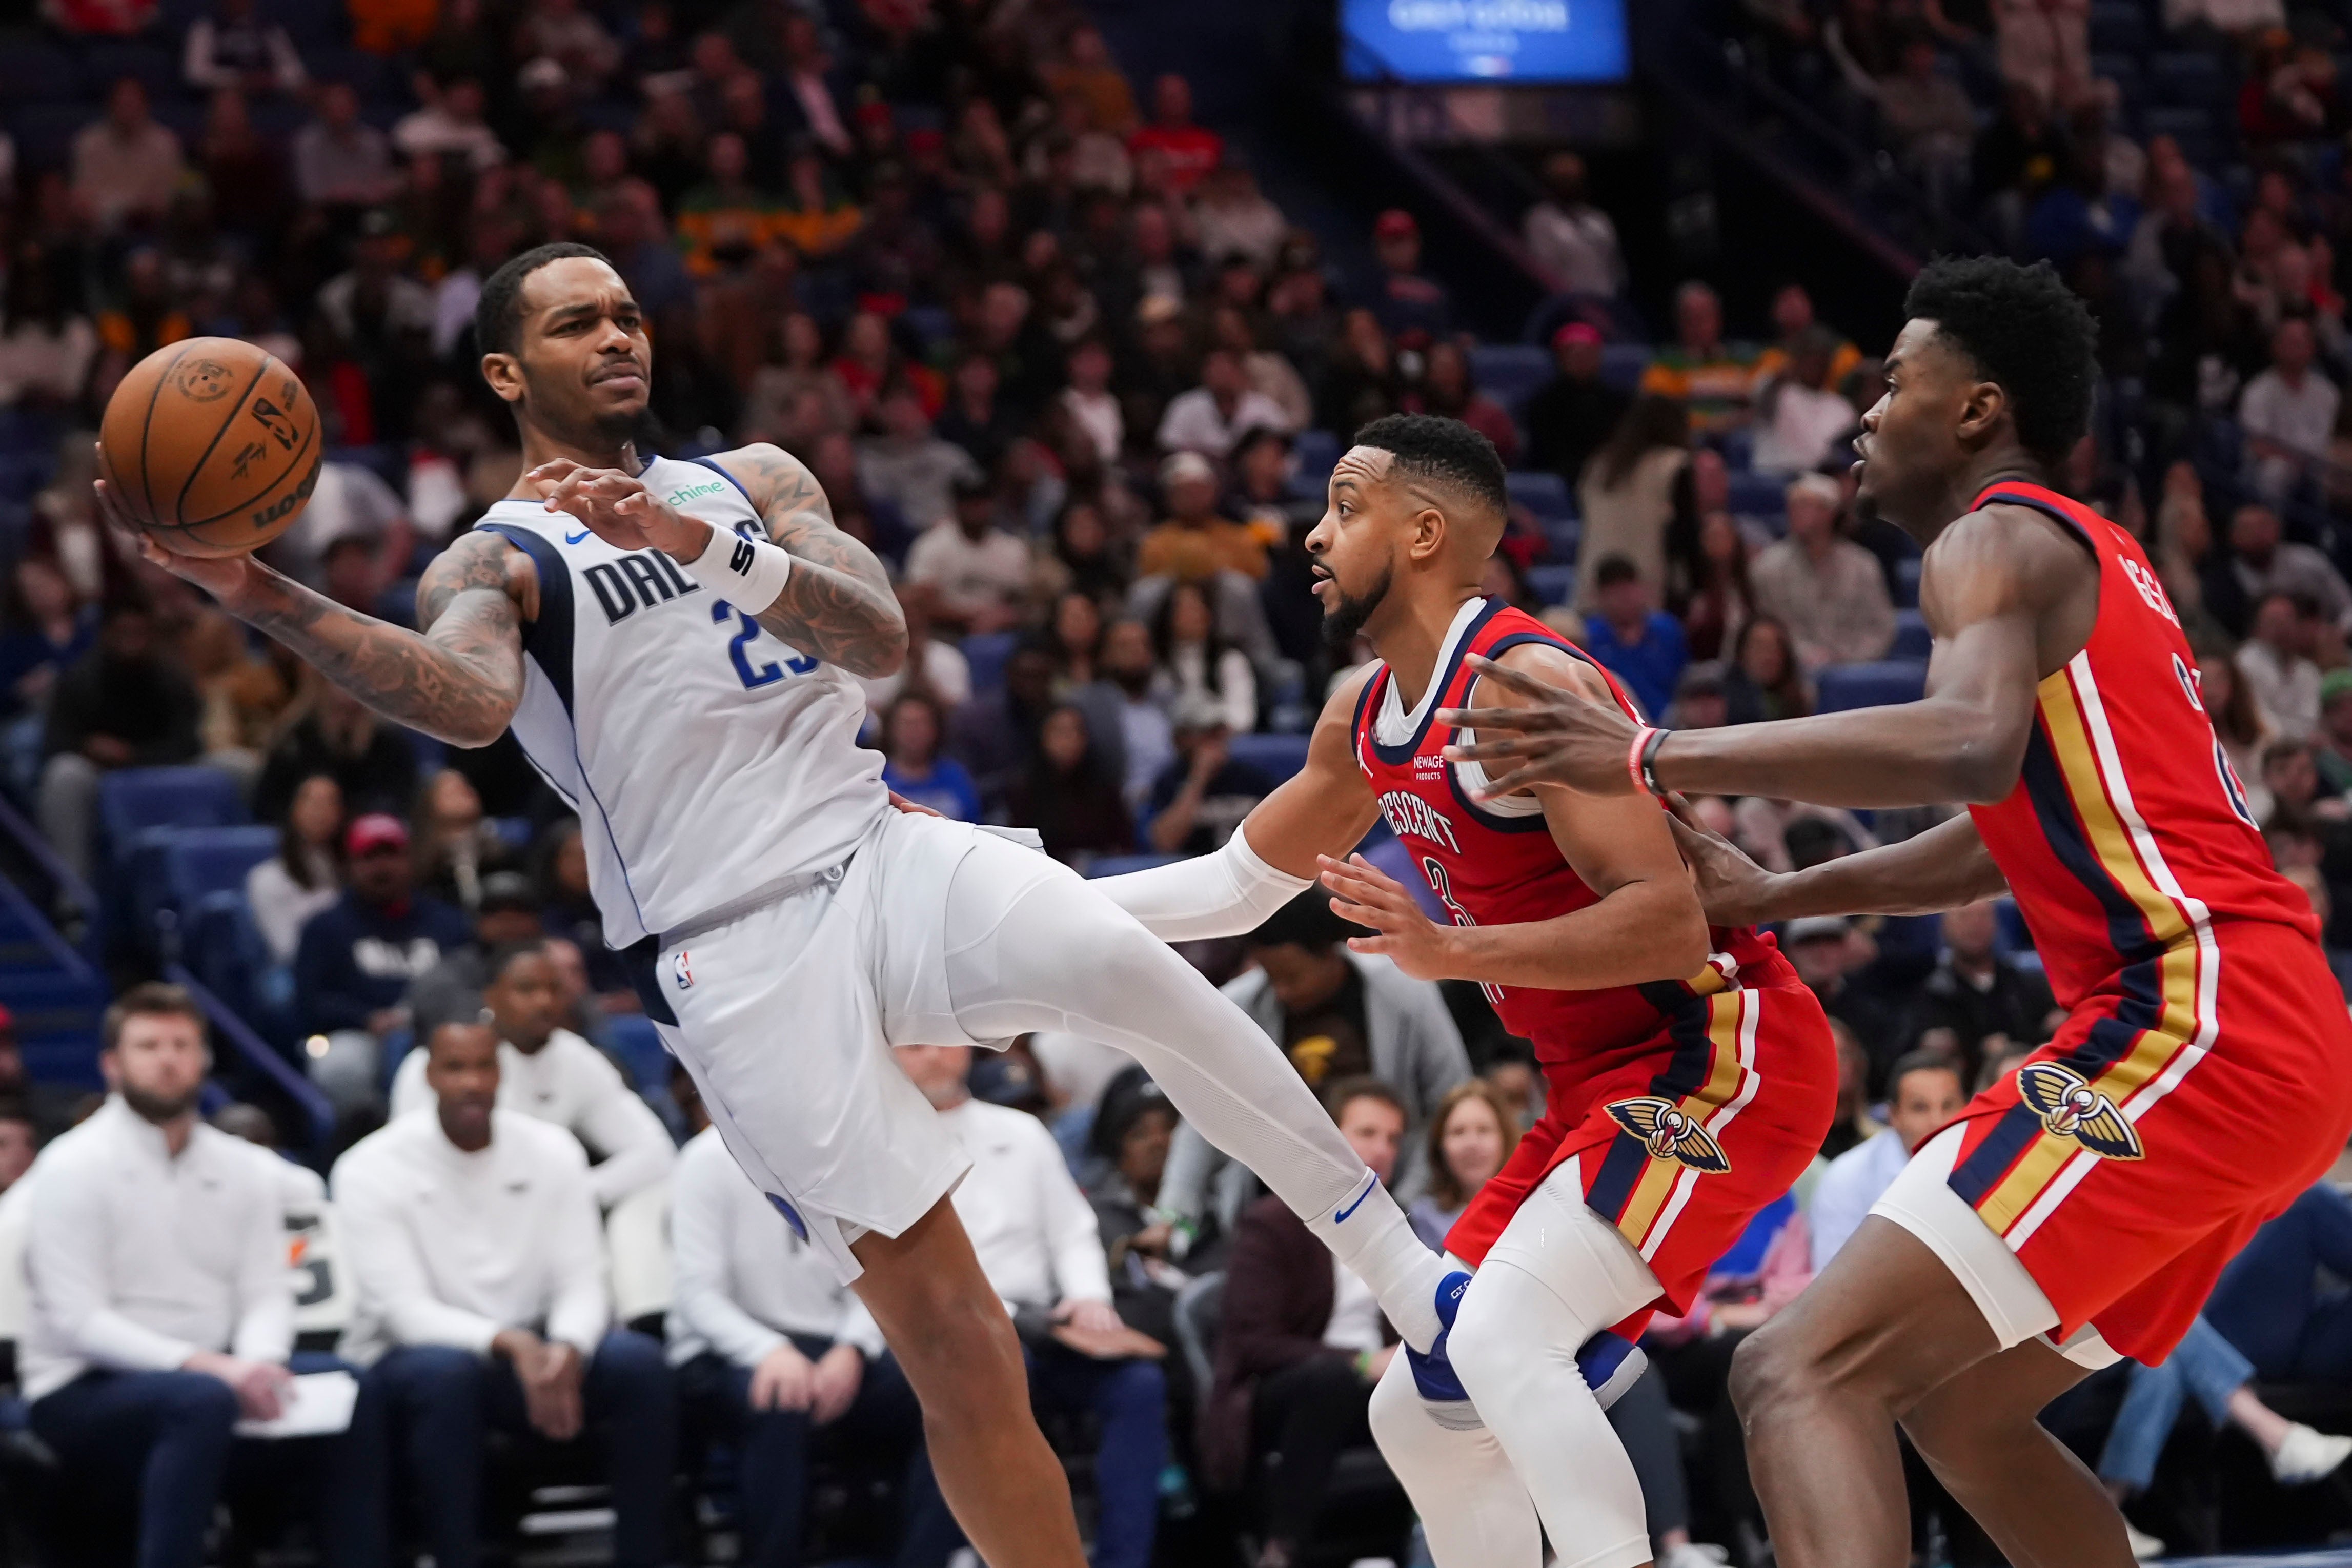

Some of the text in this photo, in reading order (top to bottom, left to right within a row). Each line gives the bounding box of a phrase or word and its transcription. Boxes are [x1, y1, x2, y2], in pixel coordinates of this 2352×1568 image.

[667, 481, 725, 506] chime
[711, 598, 819, 691] 2
[1413, 755, 1444, 769] NEWAGE
[1416, 771, 1441, 780] PRODUCTS
[1377, 790, 1461, 854] RESCENT
